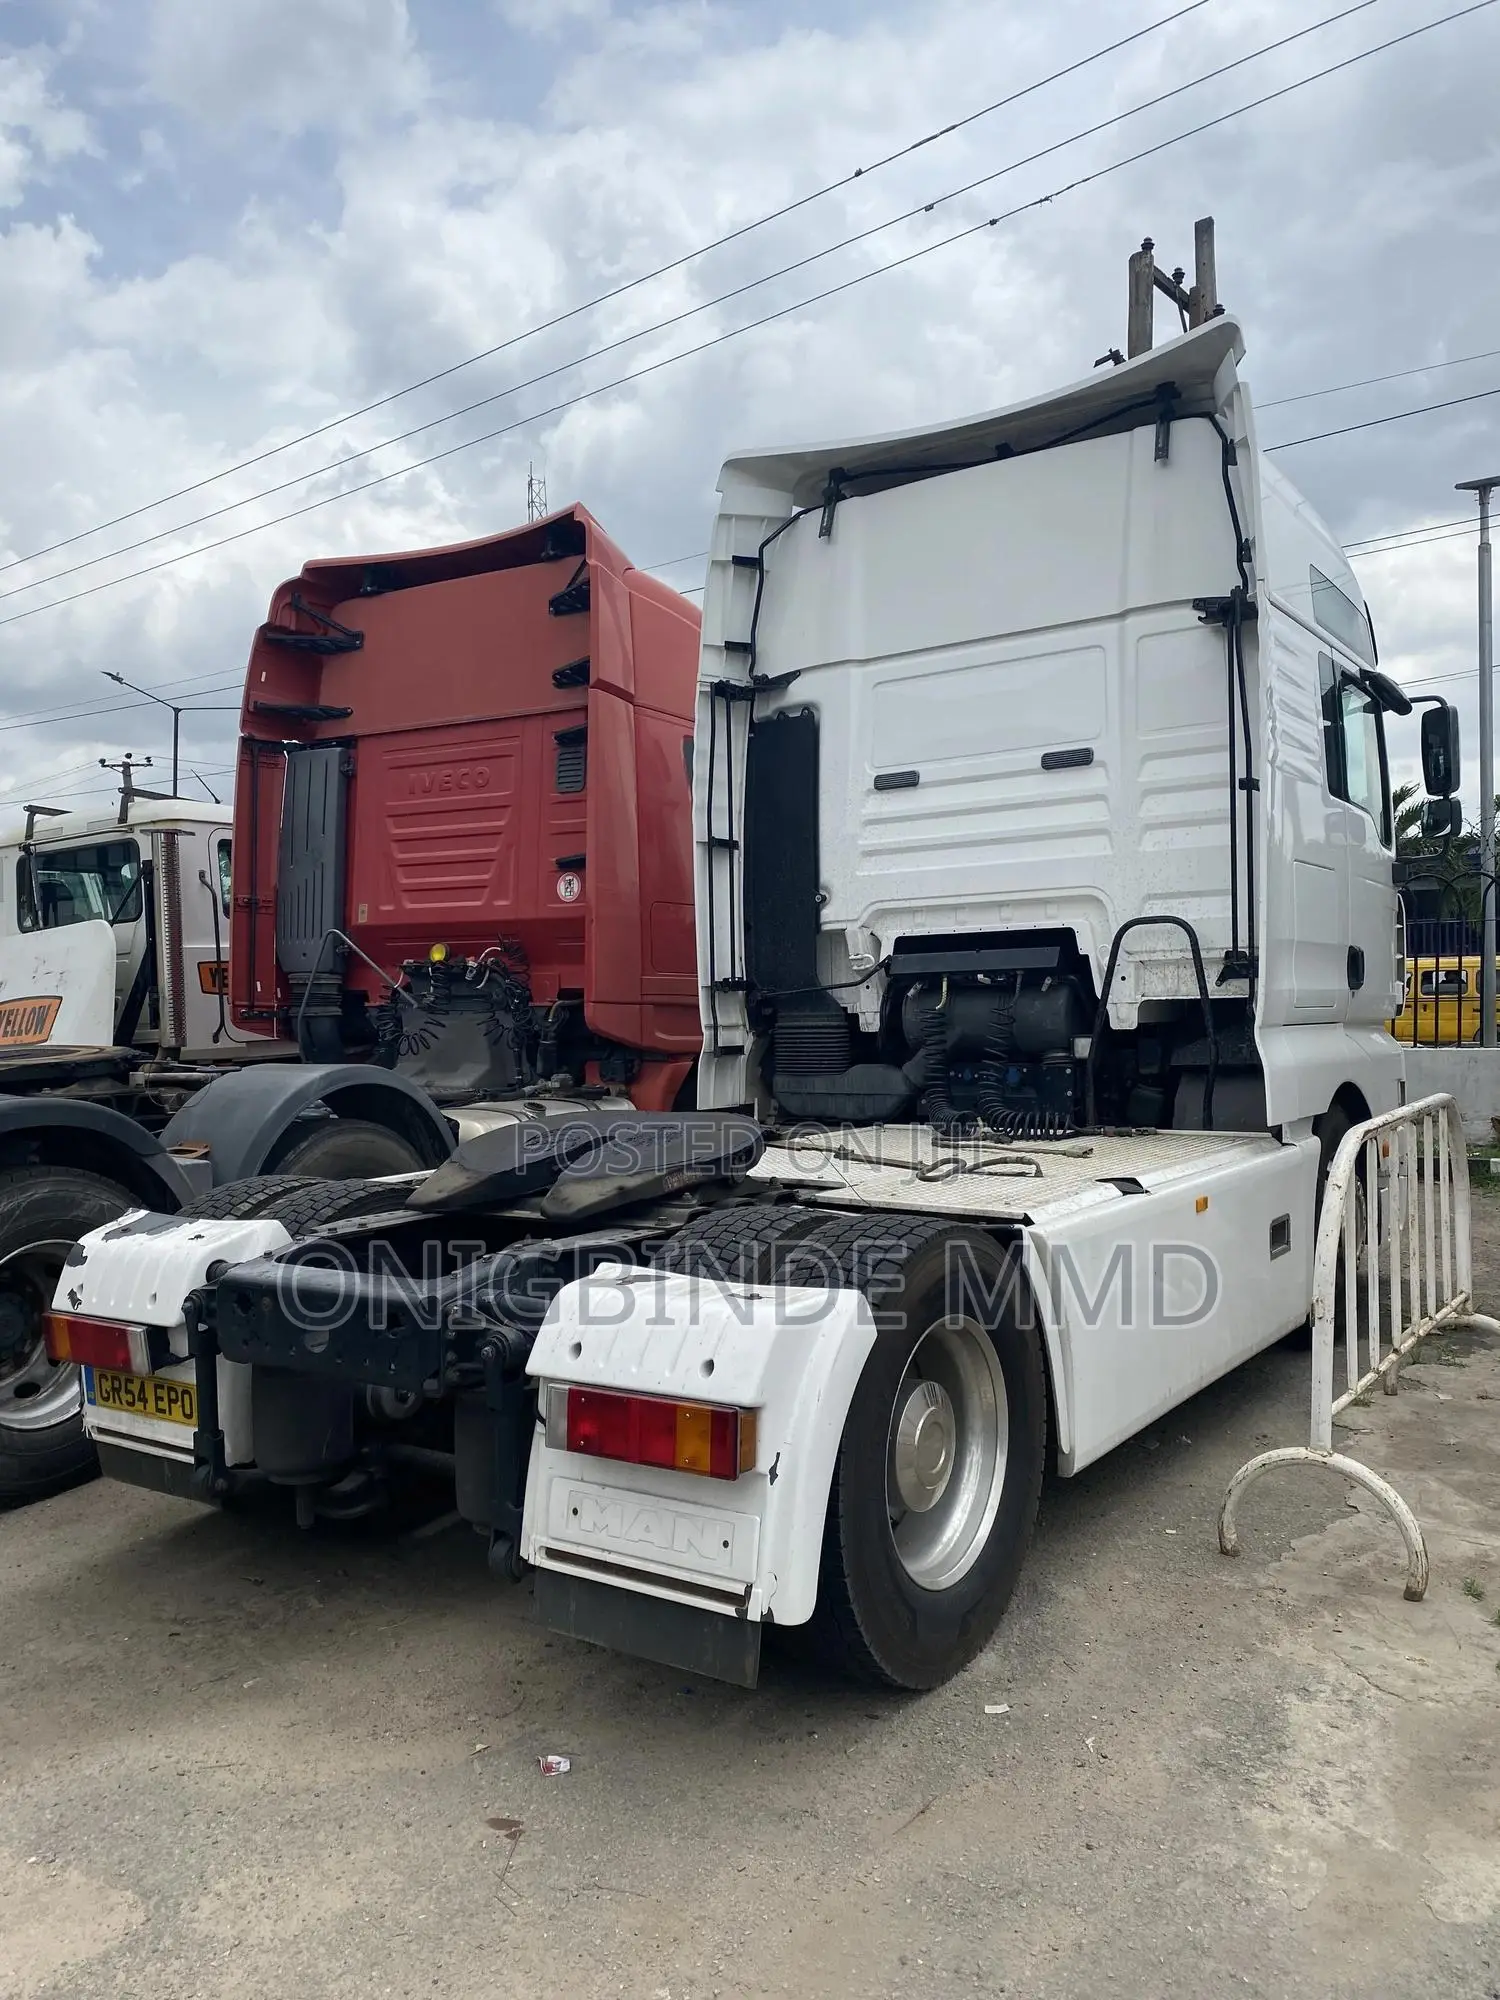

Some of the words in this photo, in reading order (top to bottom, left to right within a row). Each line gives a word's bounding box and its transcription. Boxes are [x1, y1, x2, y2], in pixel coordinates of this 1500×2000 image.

[408, 766, 491, 795] IVECO
[98, 1373, 149, 1410] GR54
[579, 1498, 721, 1561] MAN
